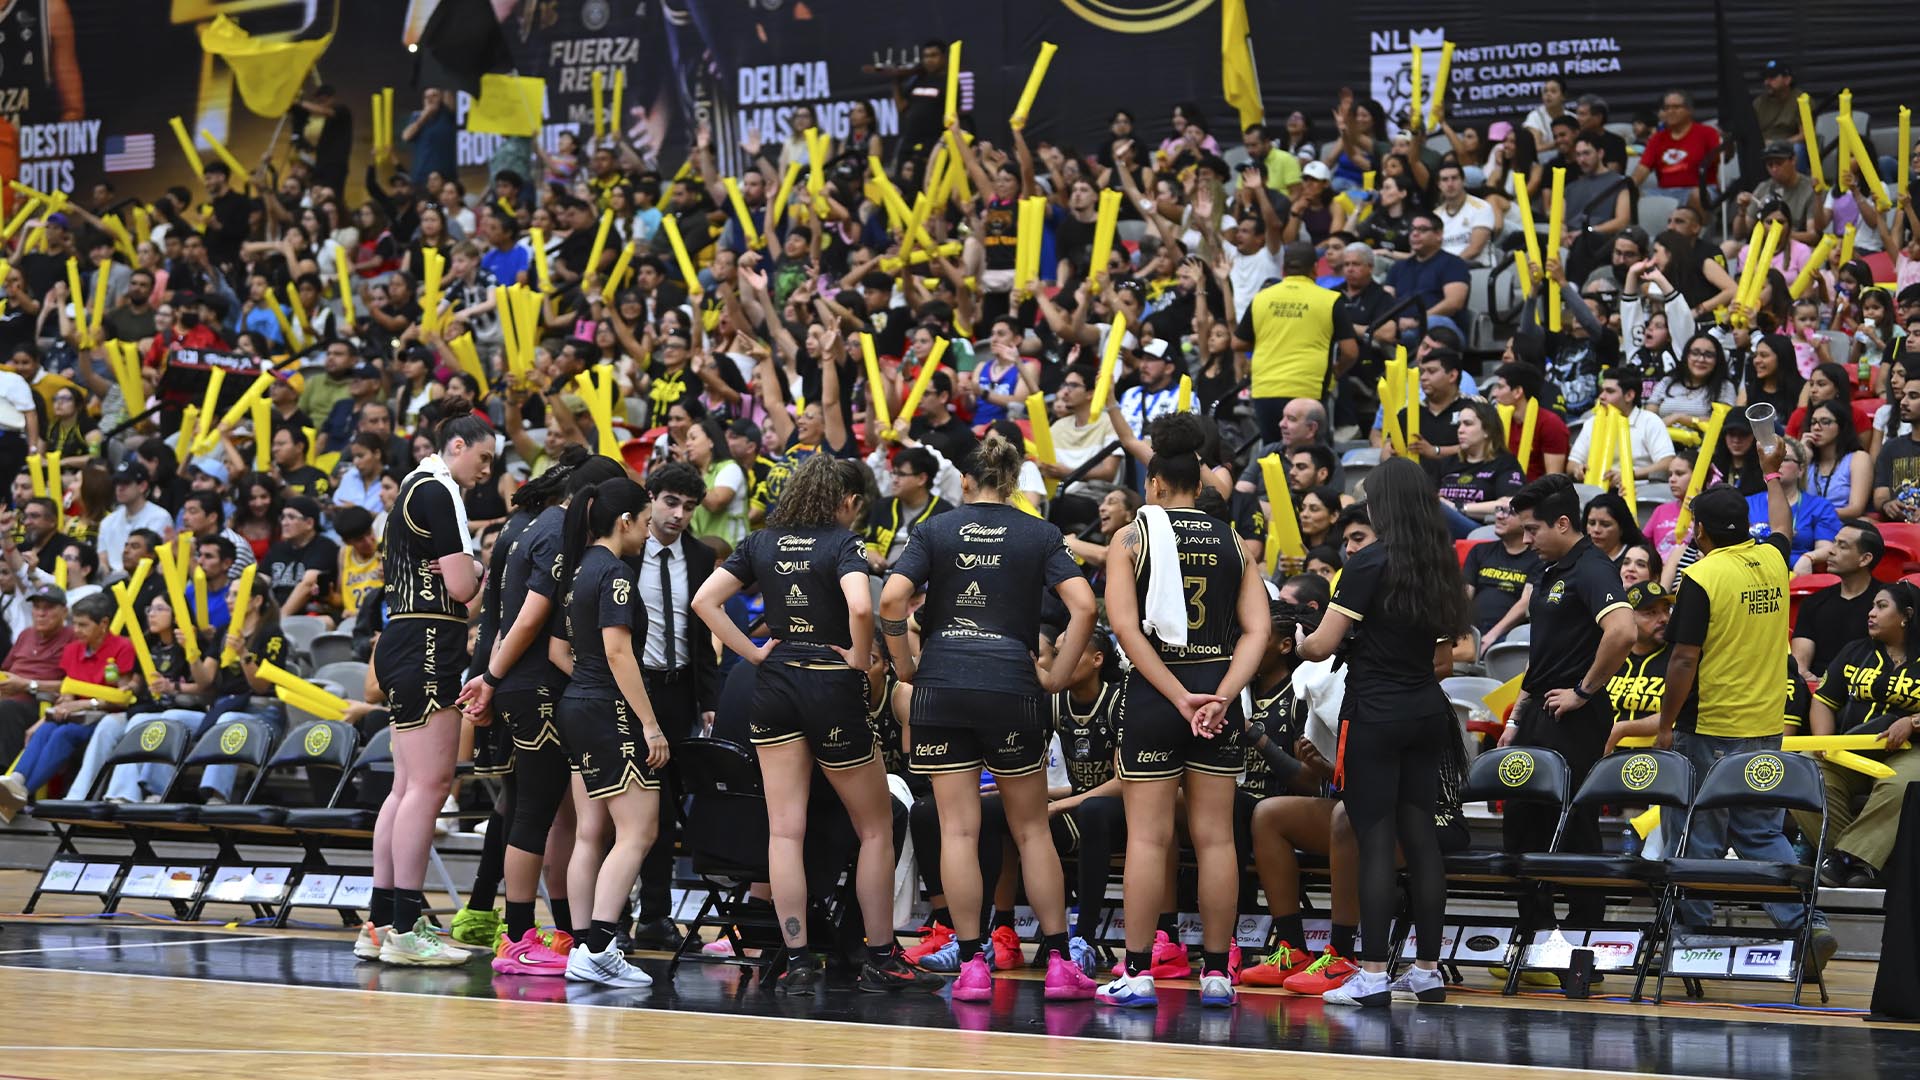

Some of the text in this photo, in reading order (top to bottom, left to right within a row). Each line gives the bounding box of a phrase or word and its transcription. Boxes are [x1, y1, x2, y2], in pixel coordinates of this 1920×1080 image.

[550, 36, 641, 66] FUERZA
[1453, 37, 1621, 63] INSTITUTO ESTATAL
[1452, 54, 1621, 83] DE CULTURA FÍSICA
[738, 60, 830, 104] DELICIA
[1452, 86, 1465, 102] Y
[20, 119, 102, 158] DESTINY
[20, 159, 75, 194] PITTS
[959, 522, 1008, 536] Caliente
[777, 535, 817, 546] Caliente
[1183, 537, 1221, 545] JAVER
[776, 560, 810, 573] VALUE
[958, 553, 1002, 567] VALUE
[1179, 553, 1218, 566] PITTS
[1183, 575, 1207, 630] 3
[1741, 587, 1783, 604] FUERZA
[1748, 602, 1780, 615] REGIA
[915, 742, 949, 757] telcel
[1303, 929, 1330, 941] ECATE
[1681, 949, 1723, 962] Sprite
[1751, 952, 1777, 964] Tuk
